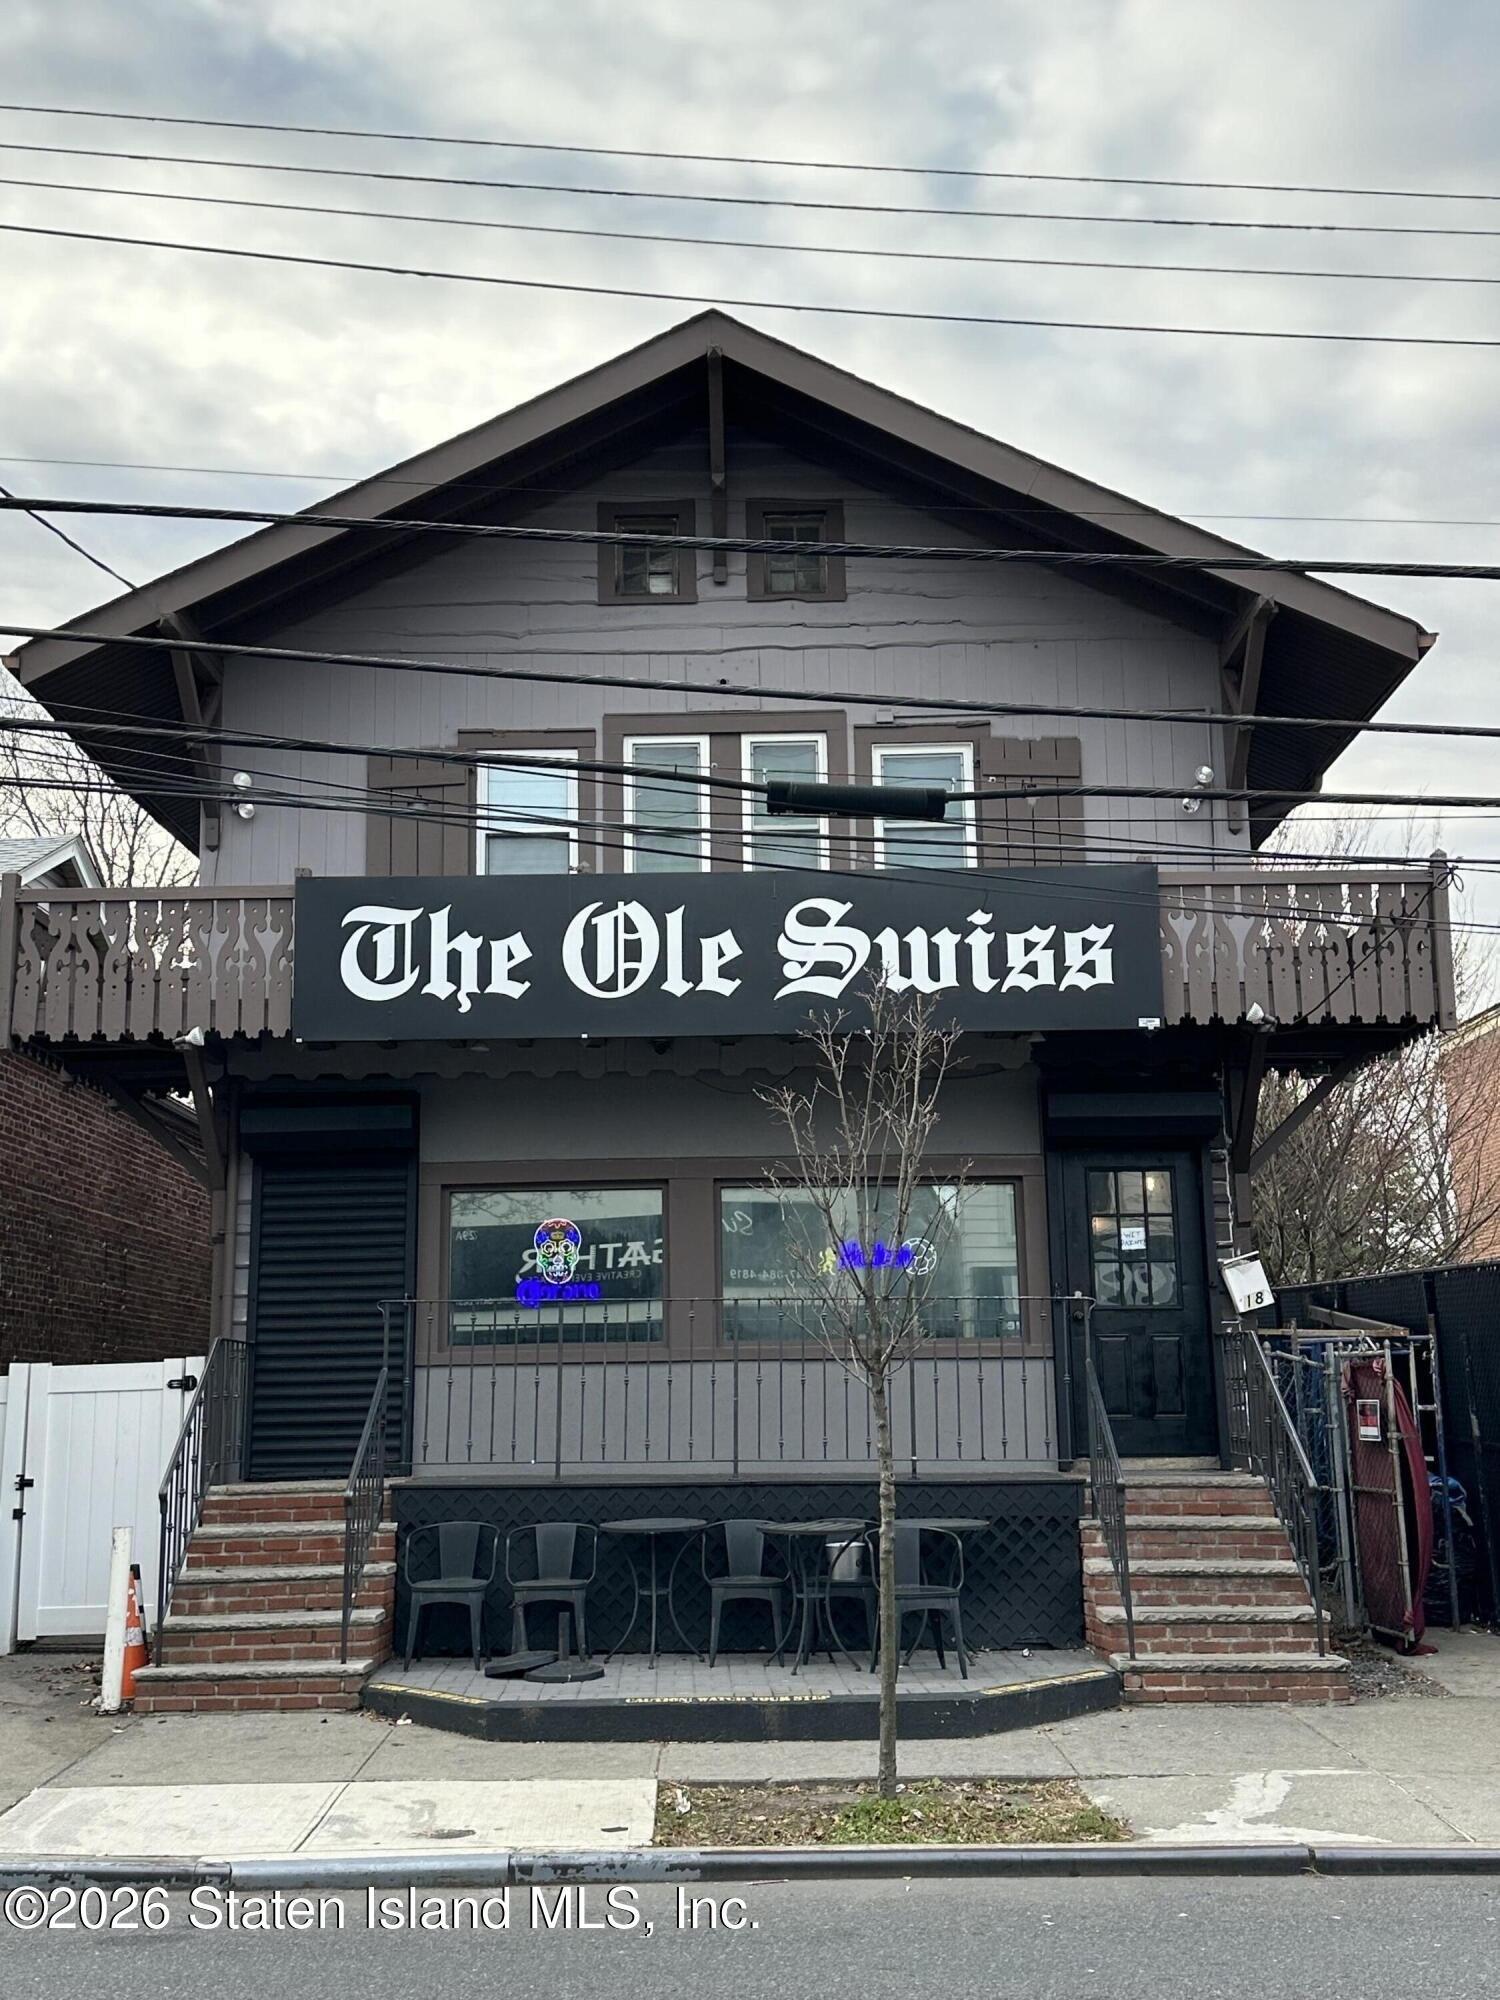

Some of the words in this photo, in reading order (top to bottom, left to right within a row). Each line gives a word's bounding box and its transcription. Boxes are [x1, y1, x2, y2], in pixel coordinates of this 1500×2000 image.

[340, 904, 533, 1014] The
[562, 900, 743, 999] Ole
[773, 897, 1115, 1001] Swiss
[1123, 1231, 1141, 1239] WET
[1247, 1291, 1264, 1308] 18
